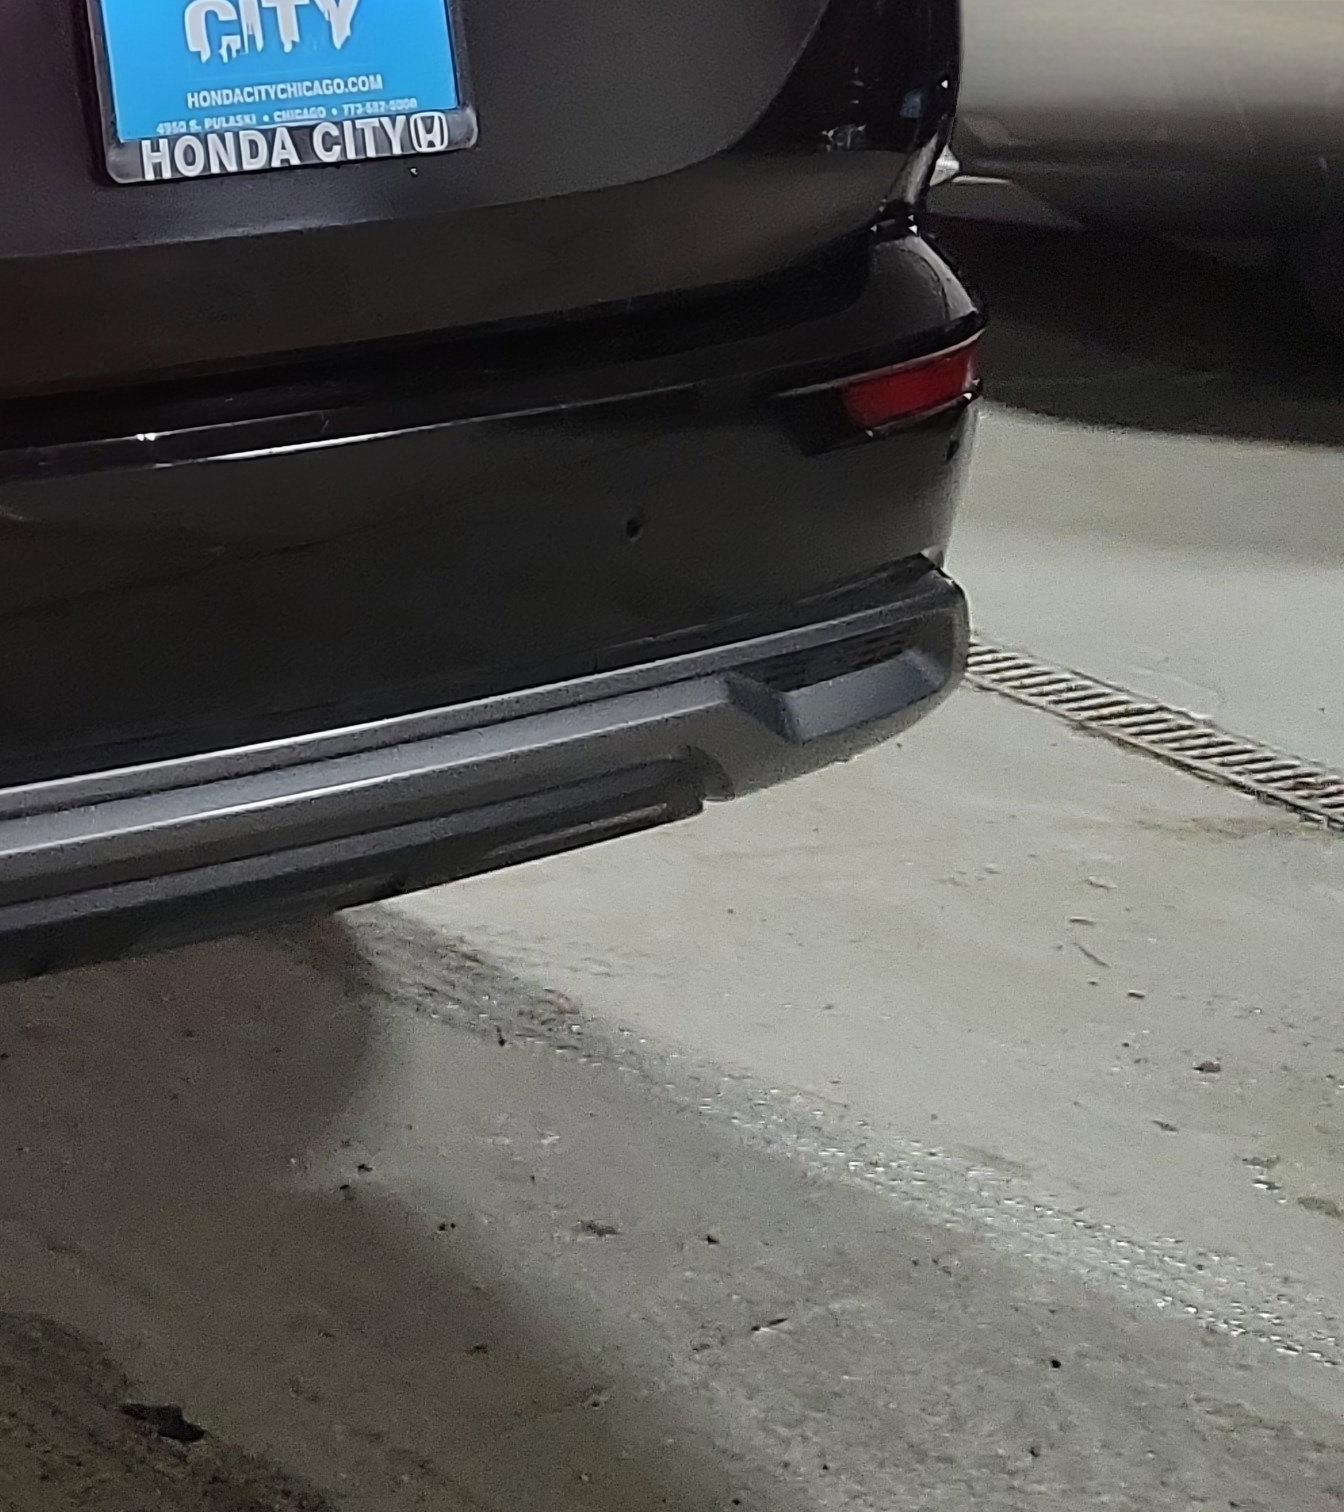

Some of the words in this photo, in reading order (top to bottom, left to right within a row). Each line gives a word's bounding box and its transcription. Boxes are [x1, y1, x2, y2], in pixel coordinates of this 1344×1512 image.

[186, 74, 384, 109] HONDACITYCHICAGO.COM
[204, 113, 257, 130] PULASKI
[273, 106, 326, 122] CHICAGO
[139, 128, 302, 181] HONDA
[312, 114, 407, 163] CITY
